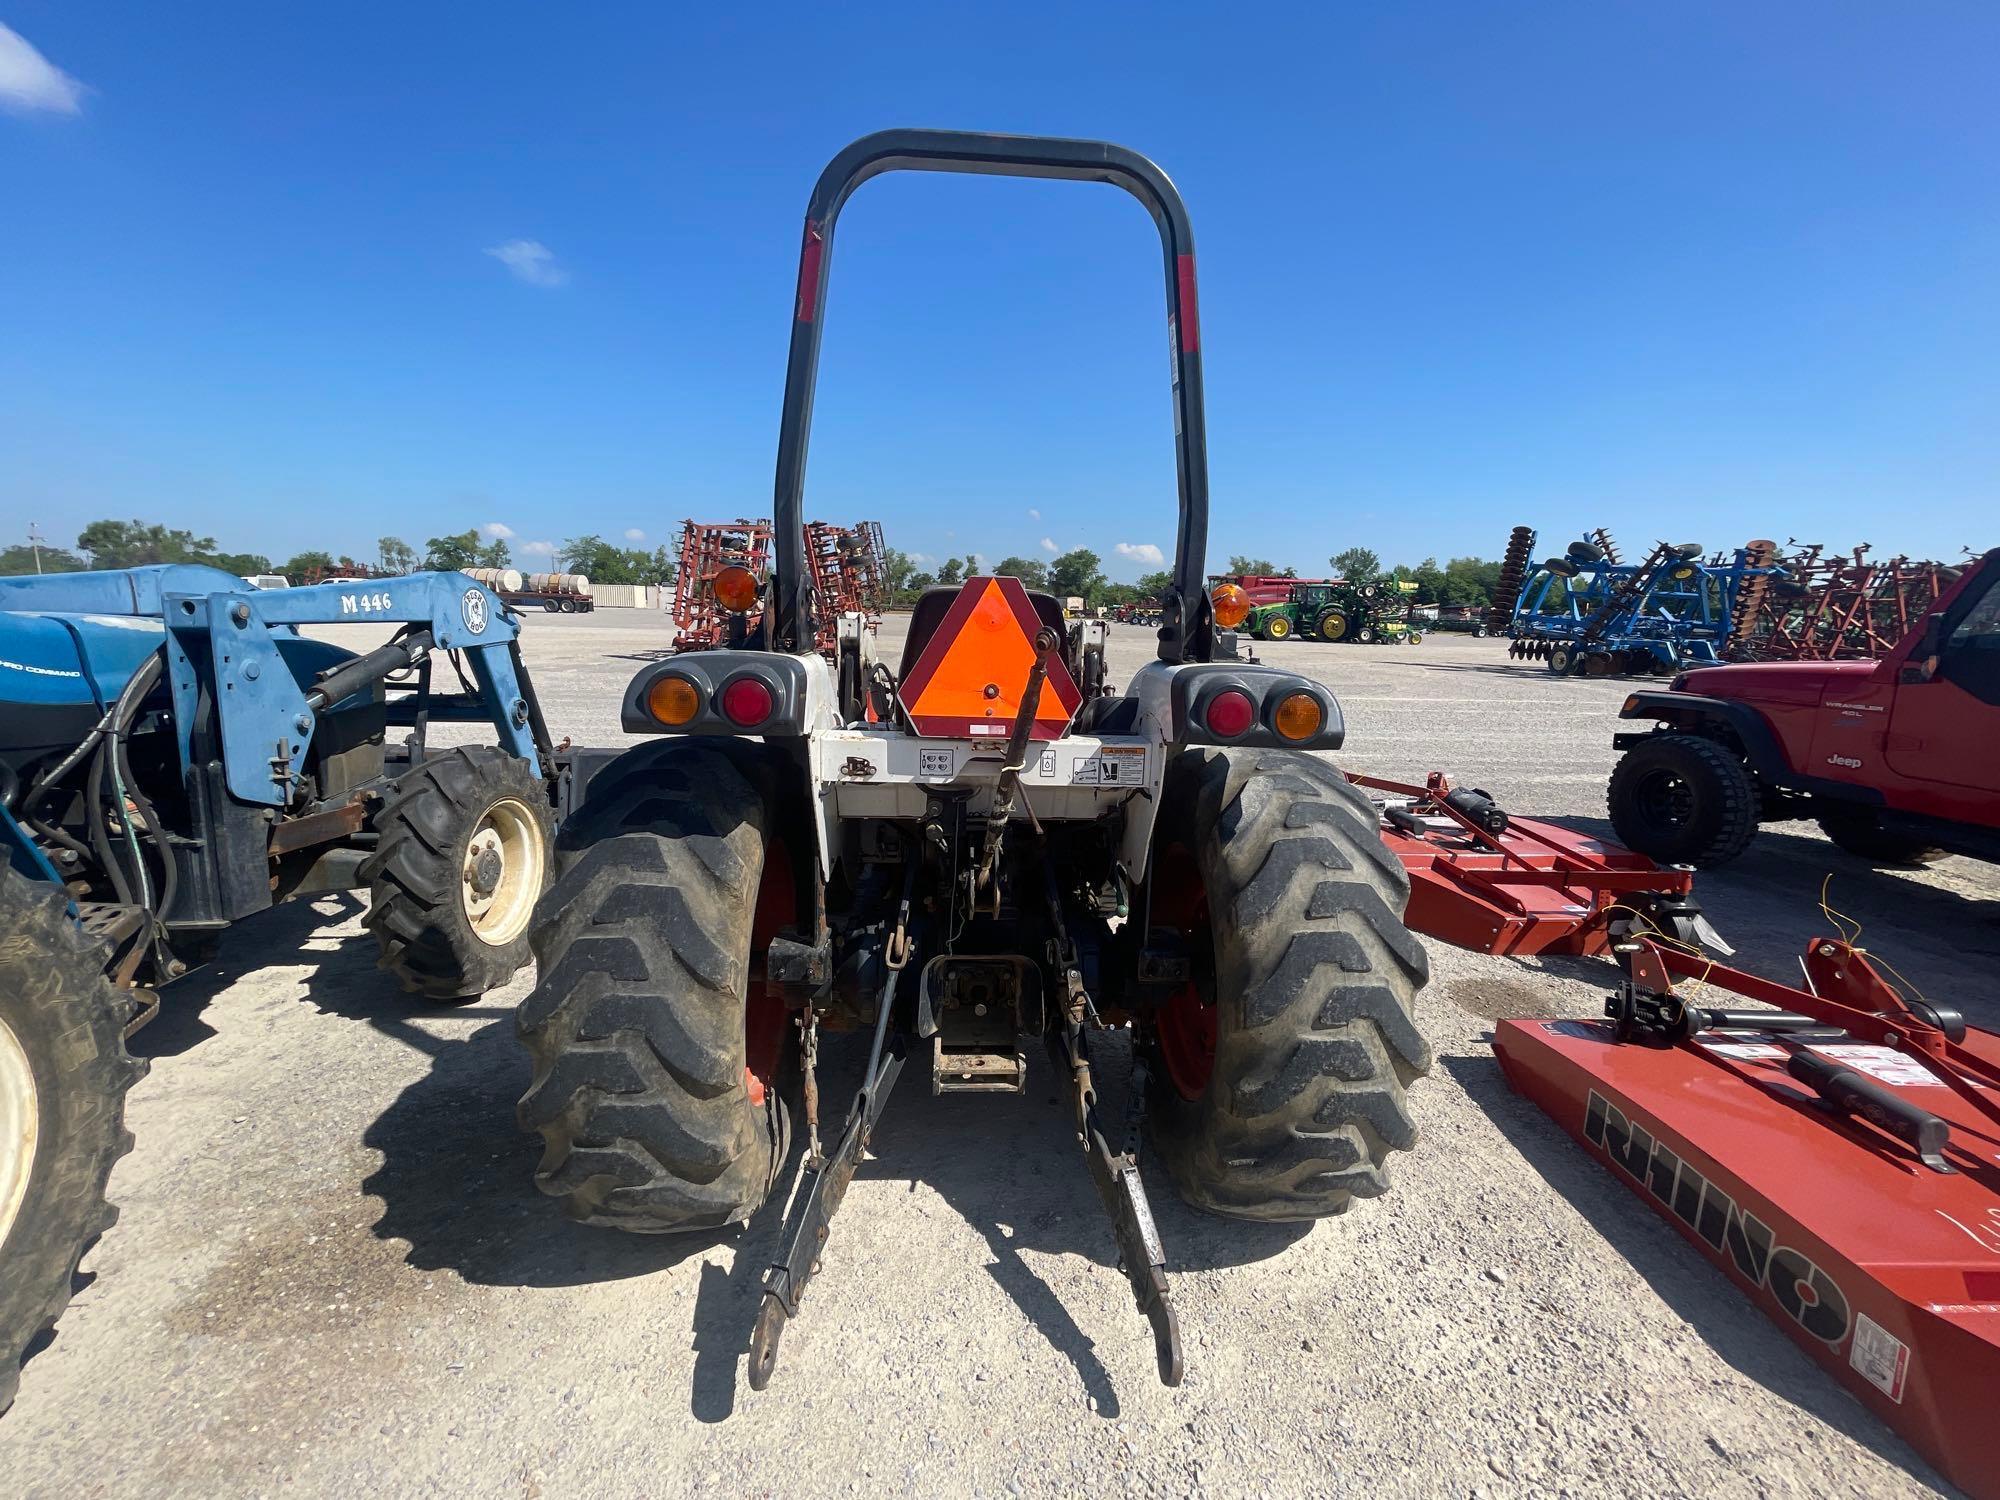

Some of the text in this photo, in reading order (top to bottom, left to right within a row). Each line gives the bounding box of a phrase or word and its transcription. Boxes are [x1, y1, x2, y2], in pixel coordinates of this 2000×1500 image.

[341, 592, 392, 614] M 446
[25, 666, 81, 677] COMMAND
[1827, 753, 1862, 769] Jeep
[1583, 1087, 1851, 1344] RHINO
